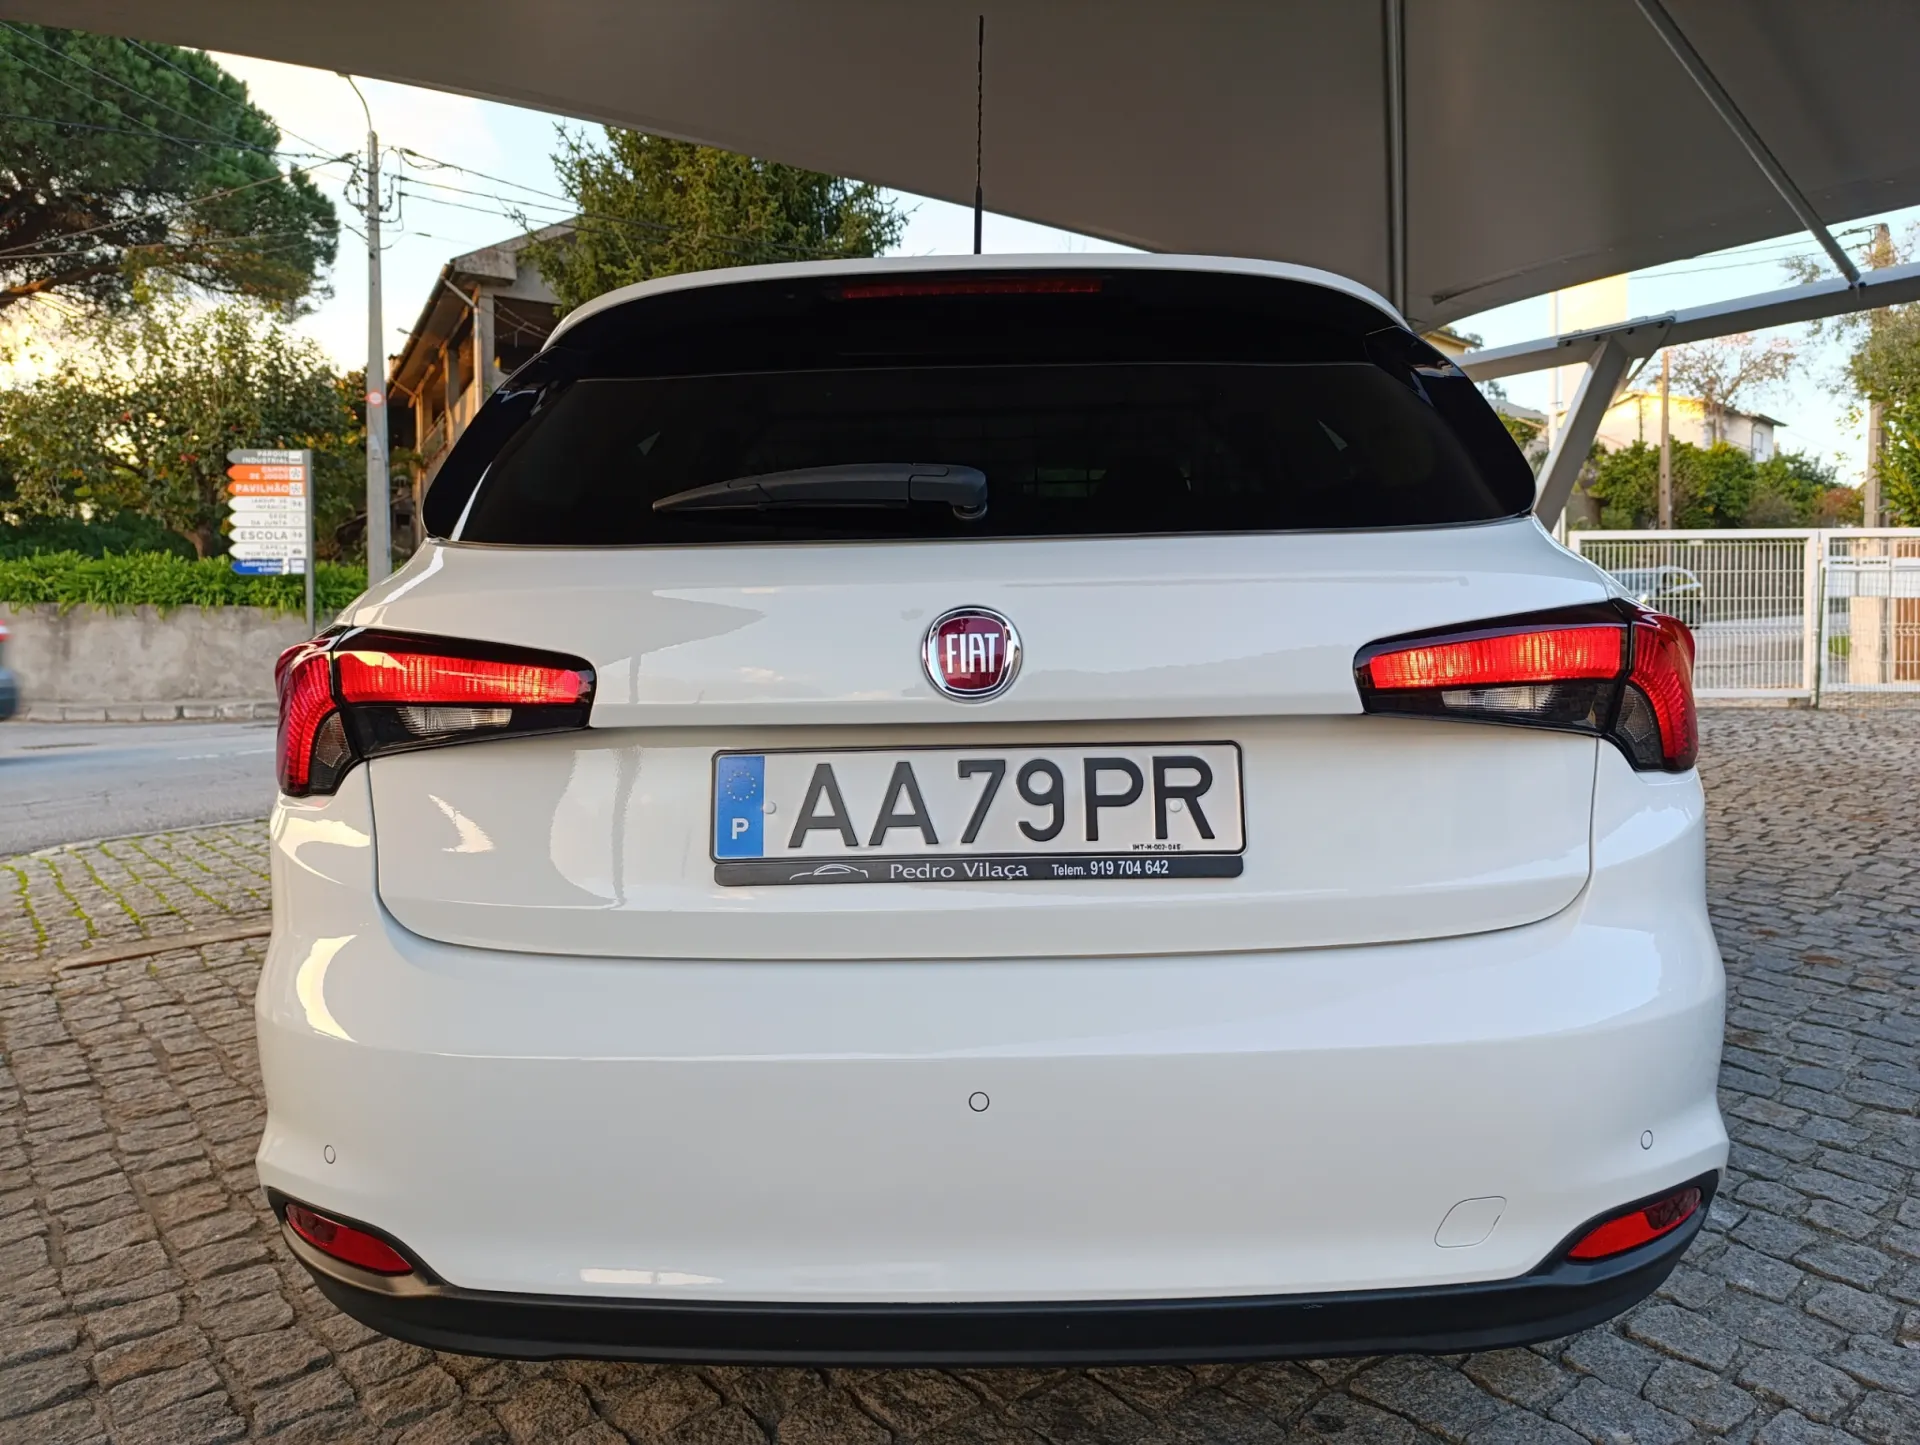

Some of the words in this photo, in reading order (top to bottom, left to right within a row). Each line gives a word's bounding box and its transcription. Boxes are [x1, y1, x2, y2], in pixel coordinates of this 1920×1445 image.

[235, 481, 289, 493] PAVILHÃO
[240, 531, 288, 540] ESCOLA
[945, 632, 1000, 674] FIAT
[787, 756, 1216, 848] AA79PR
[731, 817, 749, 840] P
[889, 863, 956, 880] Pedro
[962, 861, 1029, 880] Vilaça
[1051, 863, 1087, 876] Telem.
[1090, 861, 1115, 876] 919
[1117, 860, 1142, 876] 704
[1145, 860, 1169, 875] 642
